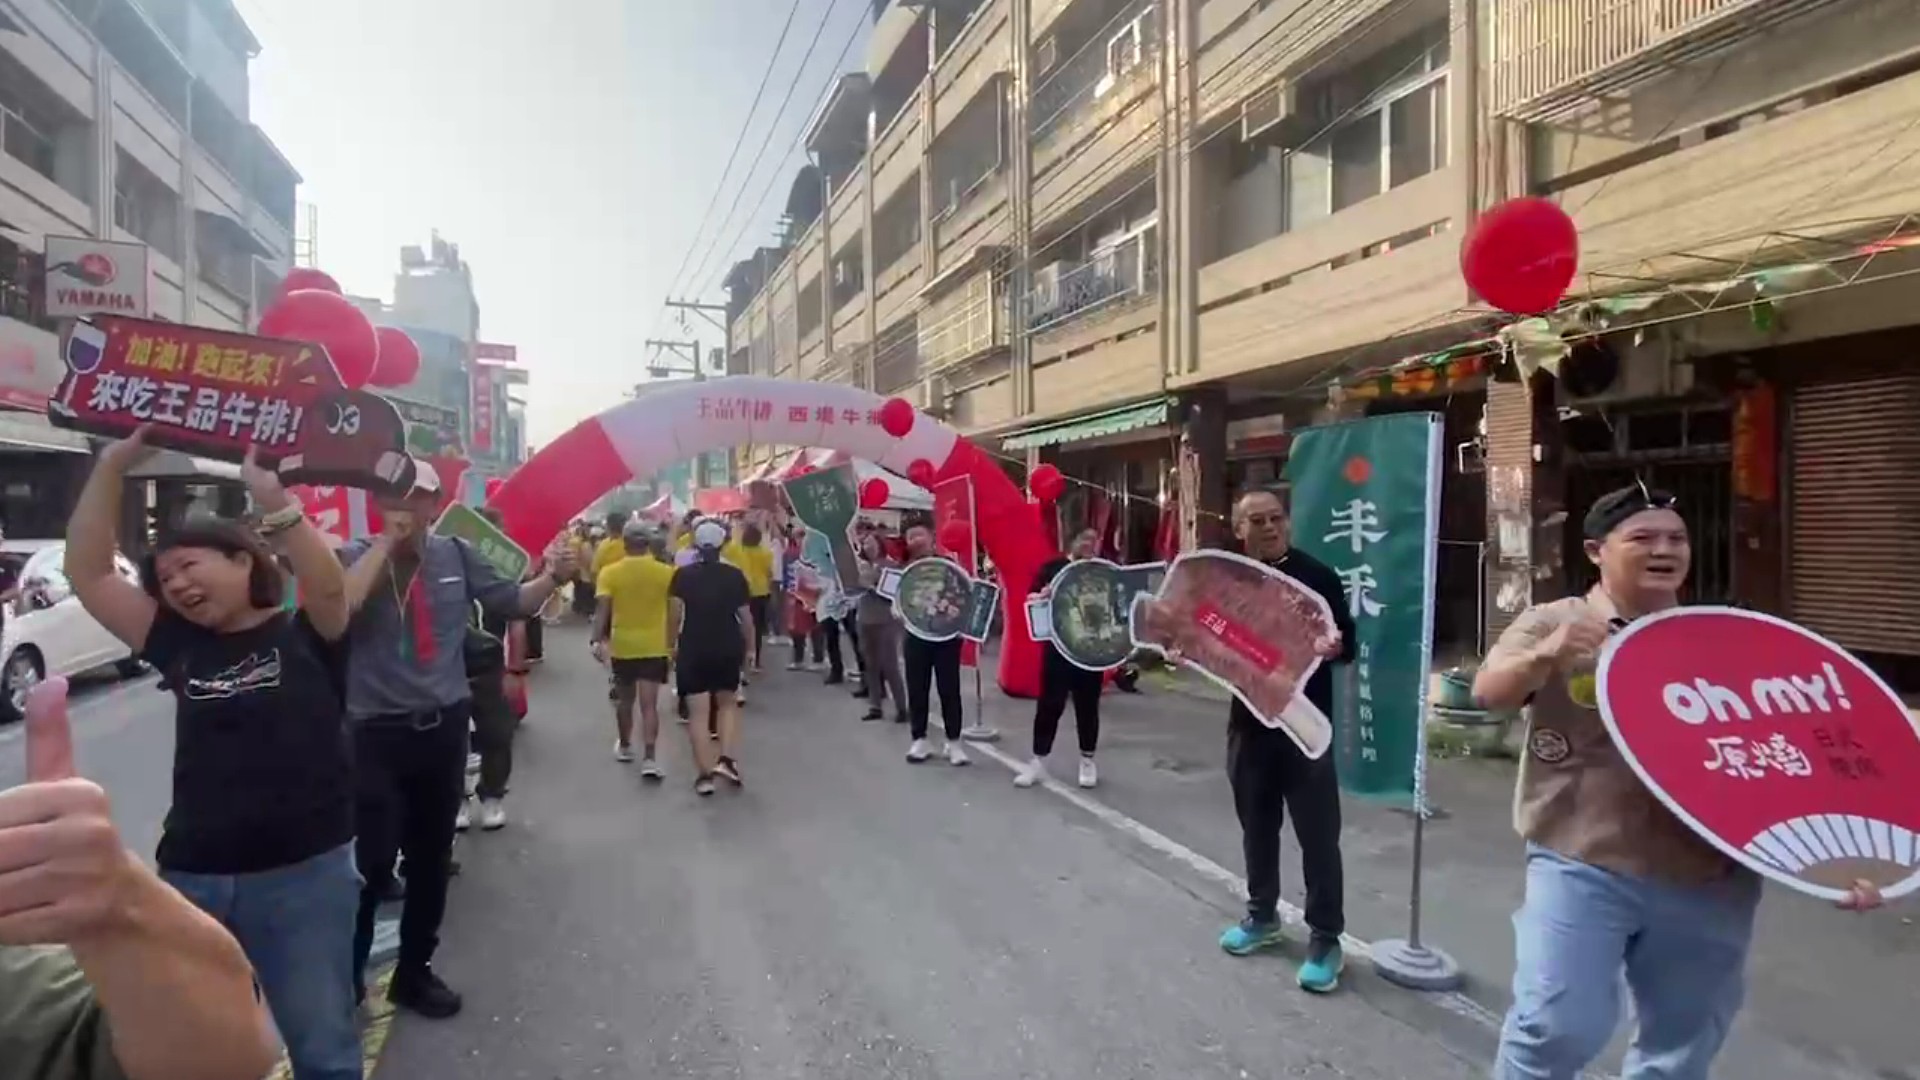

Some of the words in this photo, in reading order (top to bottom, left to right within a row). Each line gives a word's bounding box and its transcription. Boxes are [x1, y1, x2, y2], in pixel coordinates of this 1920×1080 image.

[57, 288, 136, 311] YAMAHA
[125, 333, 189, 372] 加油!
[88, 370, 304, 446] 來吃王品牛排!
